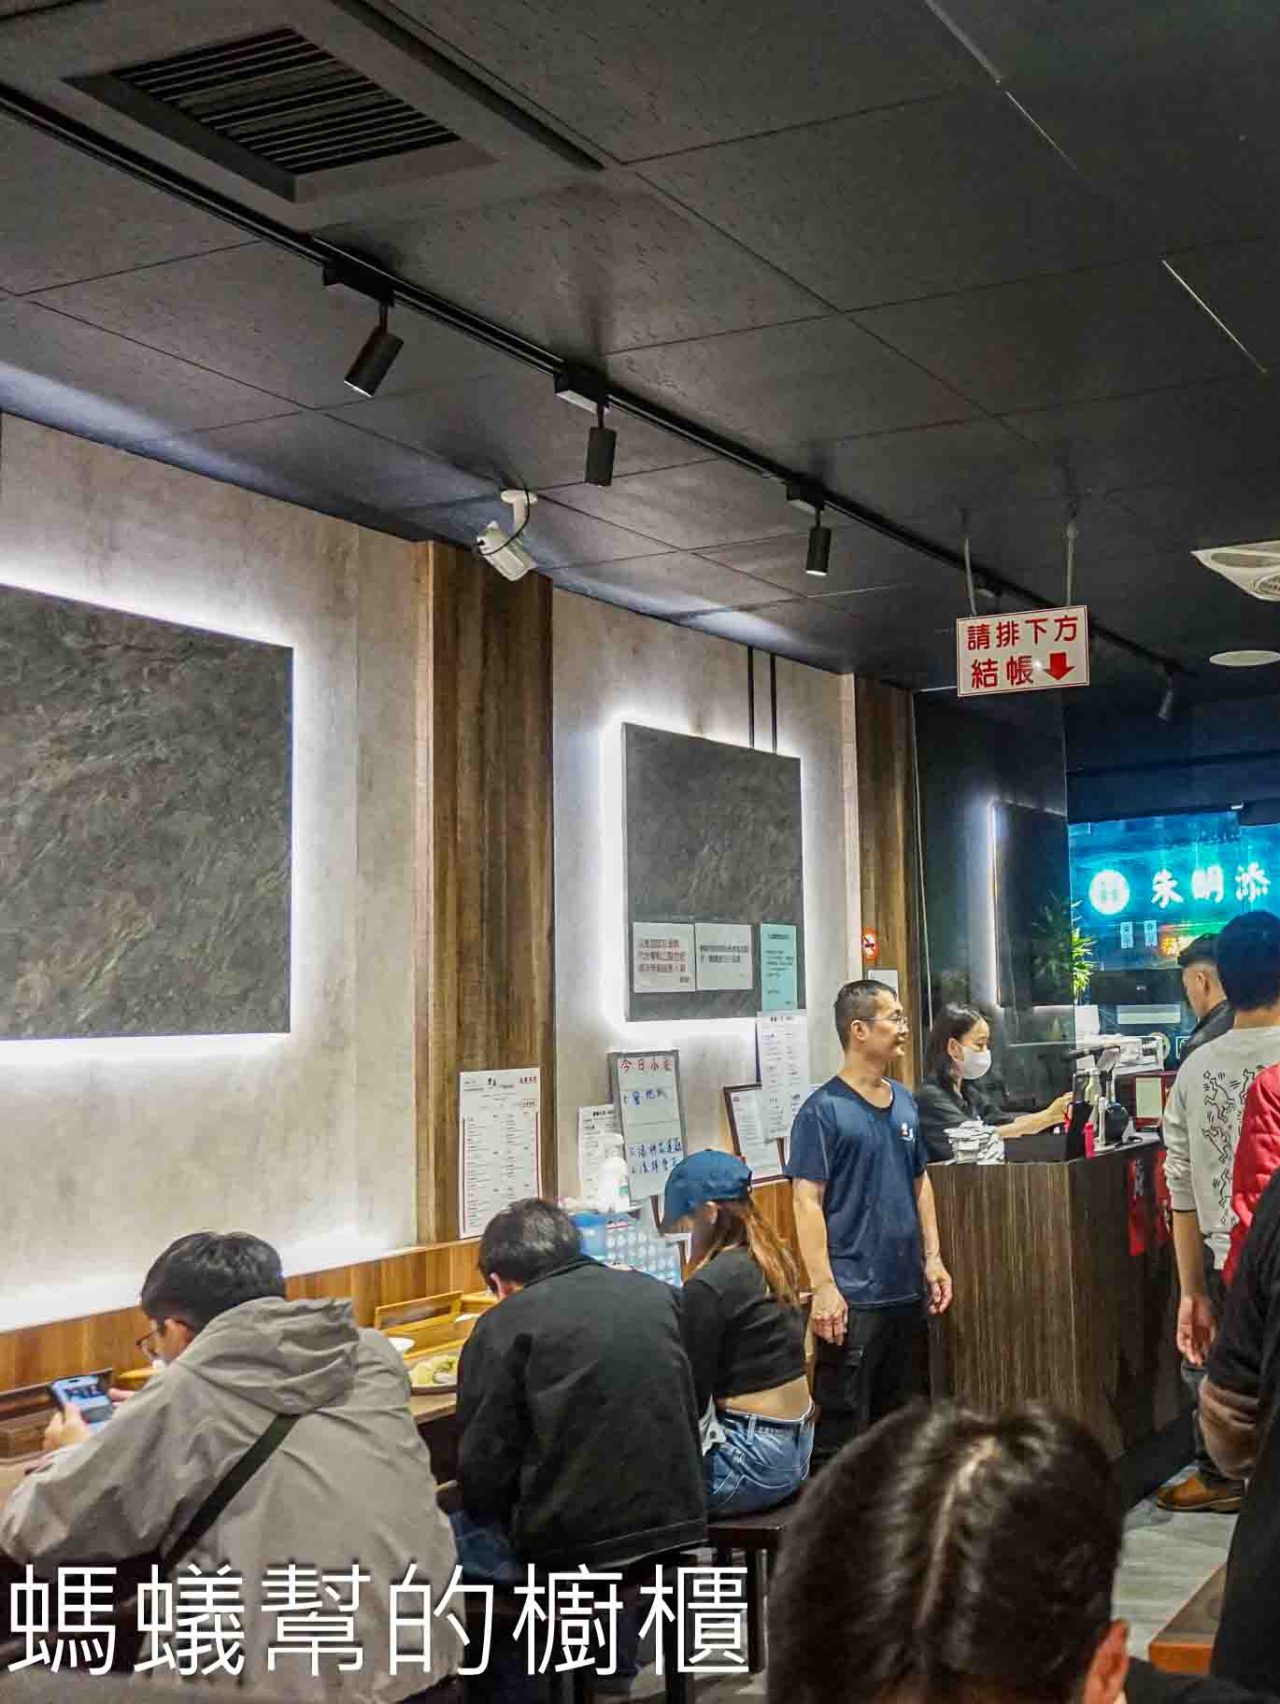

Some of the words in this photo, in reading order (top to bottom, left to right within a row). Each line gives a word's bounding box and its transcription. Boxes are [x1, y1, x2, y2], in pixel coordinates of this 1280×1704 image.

[967, 615, 1078, 650] 請排下方
[971, 655, 1034, 689] 結帳
